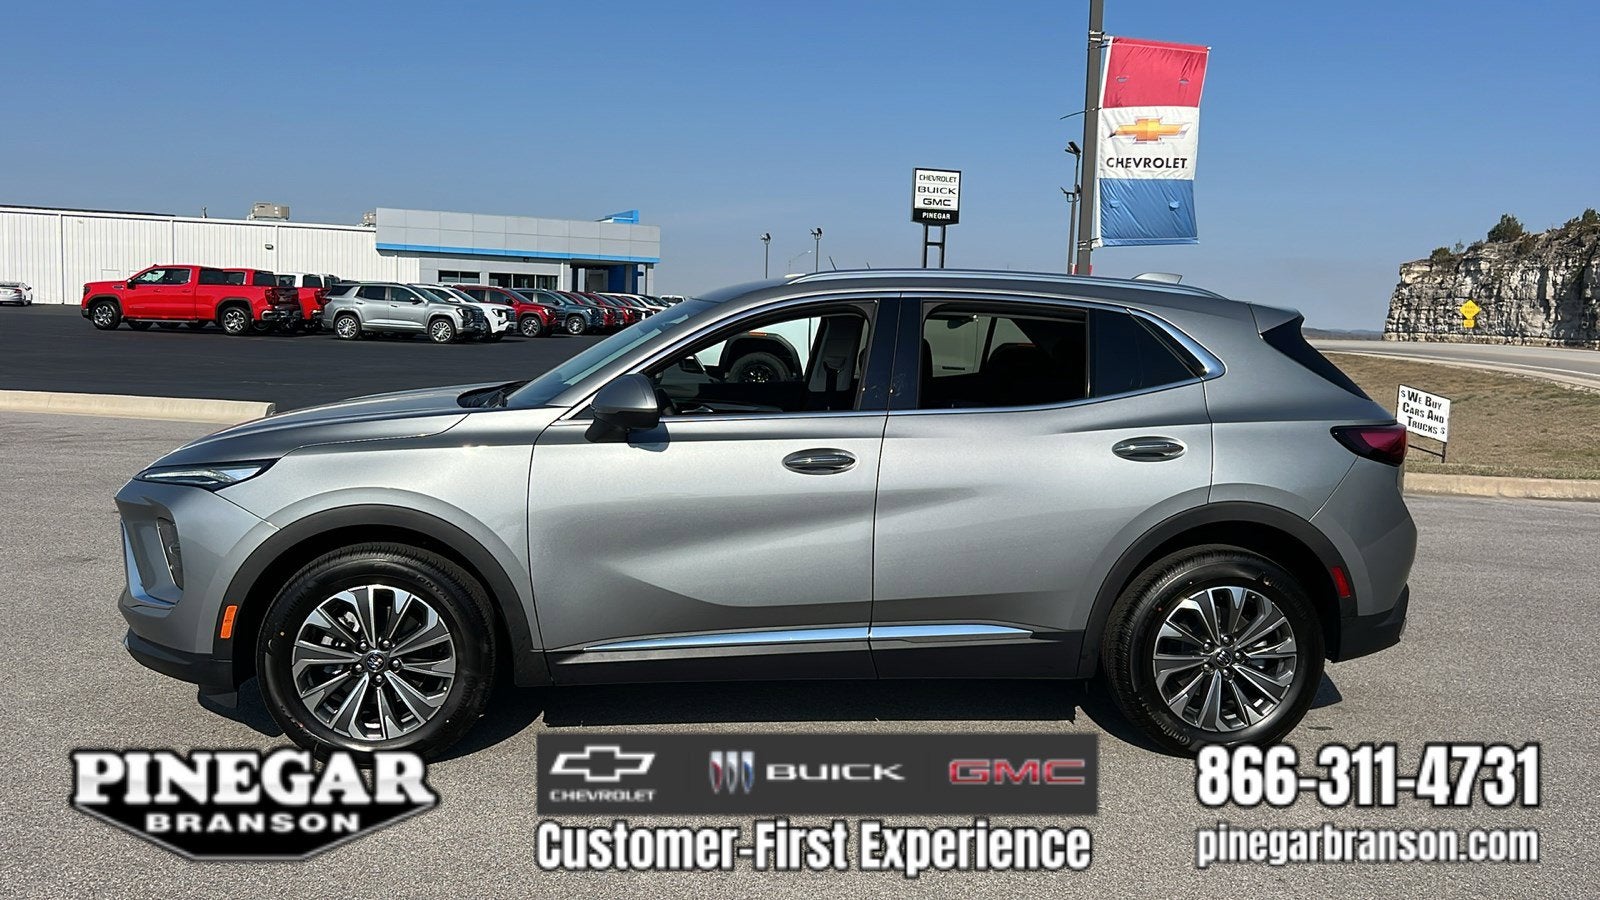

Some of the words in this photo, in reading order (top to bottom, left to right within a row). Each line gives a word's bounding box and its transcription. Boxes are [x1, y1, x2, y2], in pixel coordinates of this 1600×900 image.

[1106, 157, 1187, 169] CHEVROLET
[919, 174, 957, 183] CHEVROLET
[918, 186, 956, 195] BUICK
[922, 198, 951, 207] GMC
[922, 212, 951, 220] PINEGAR
